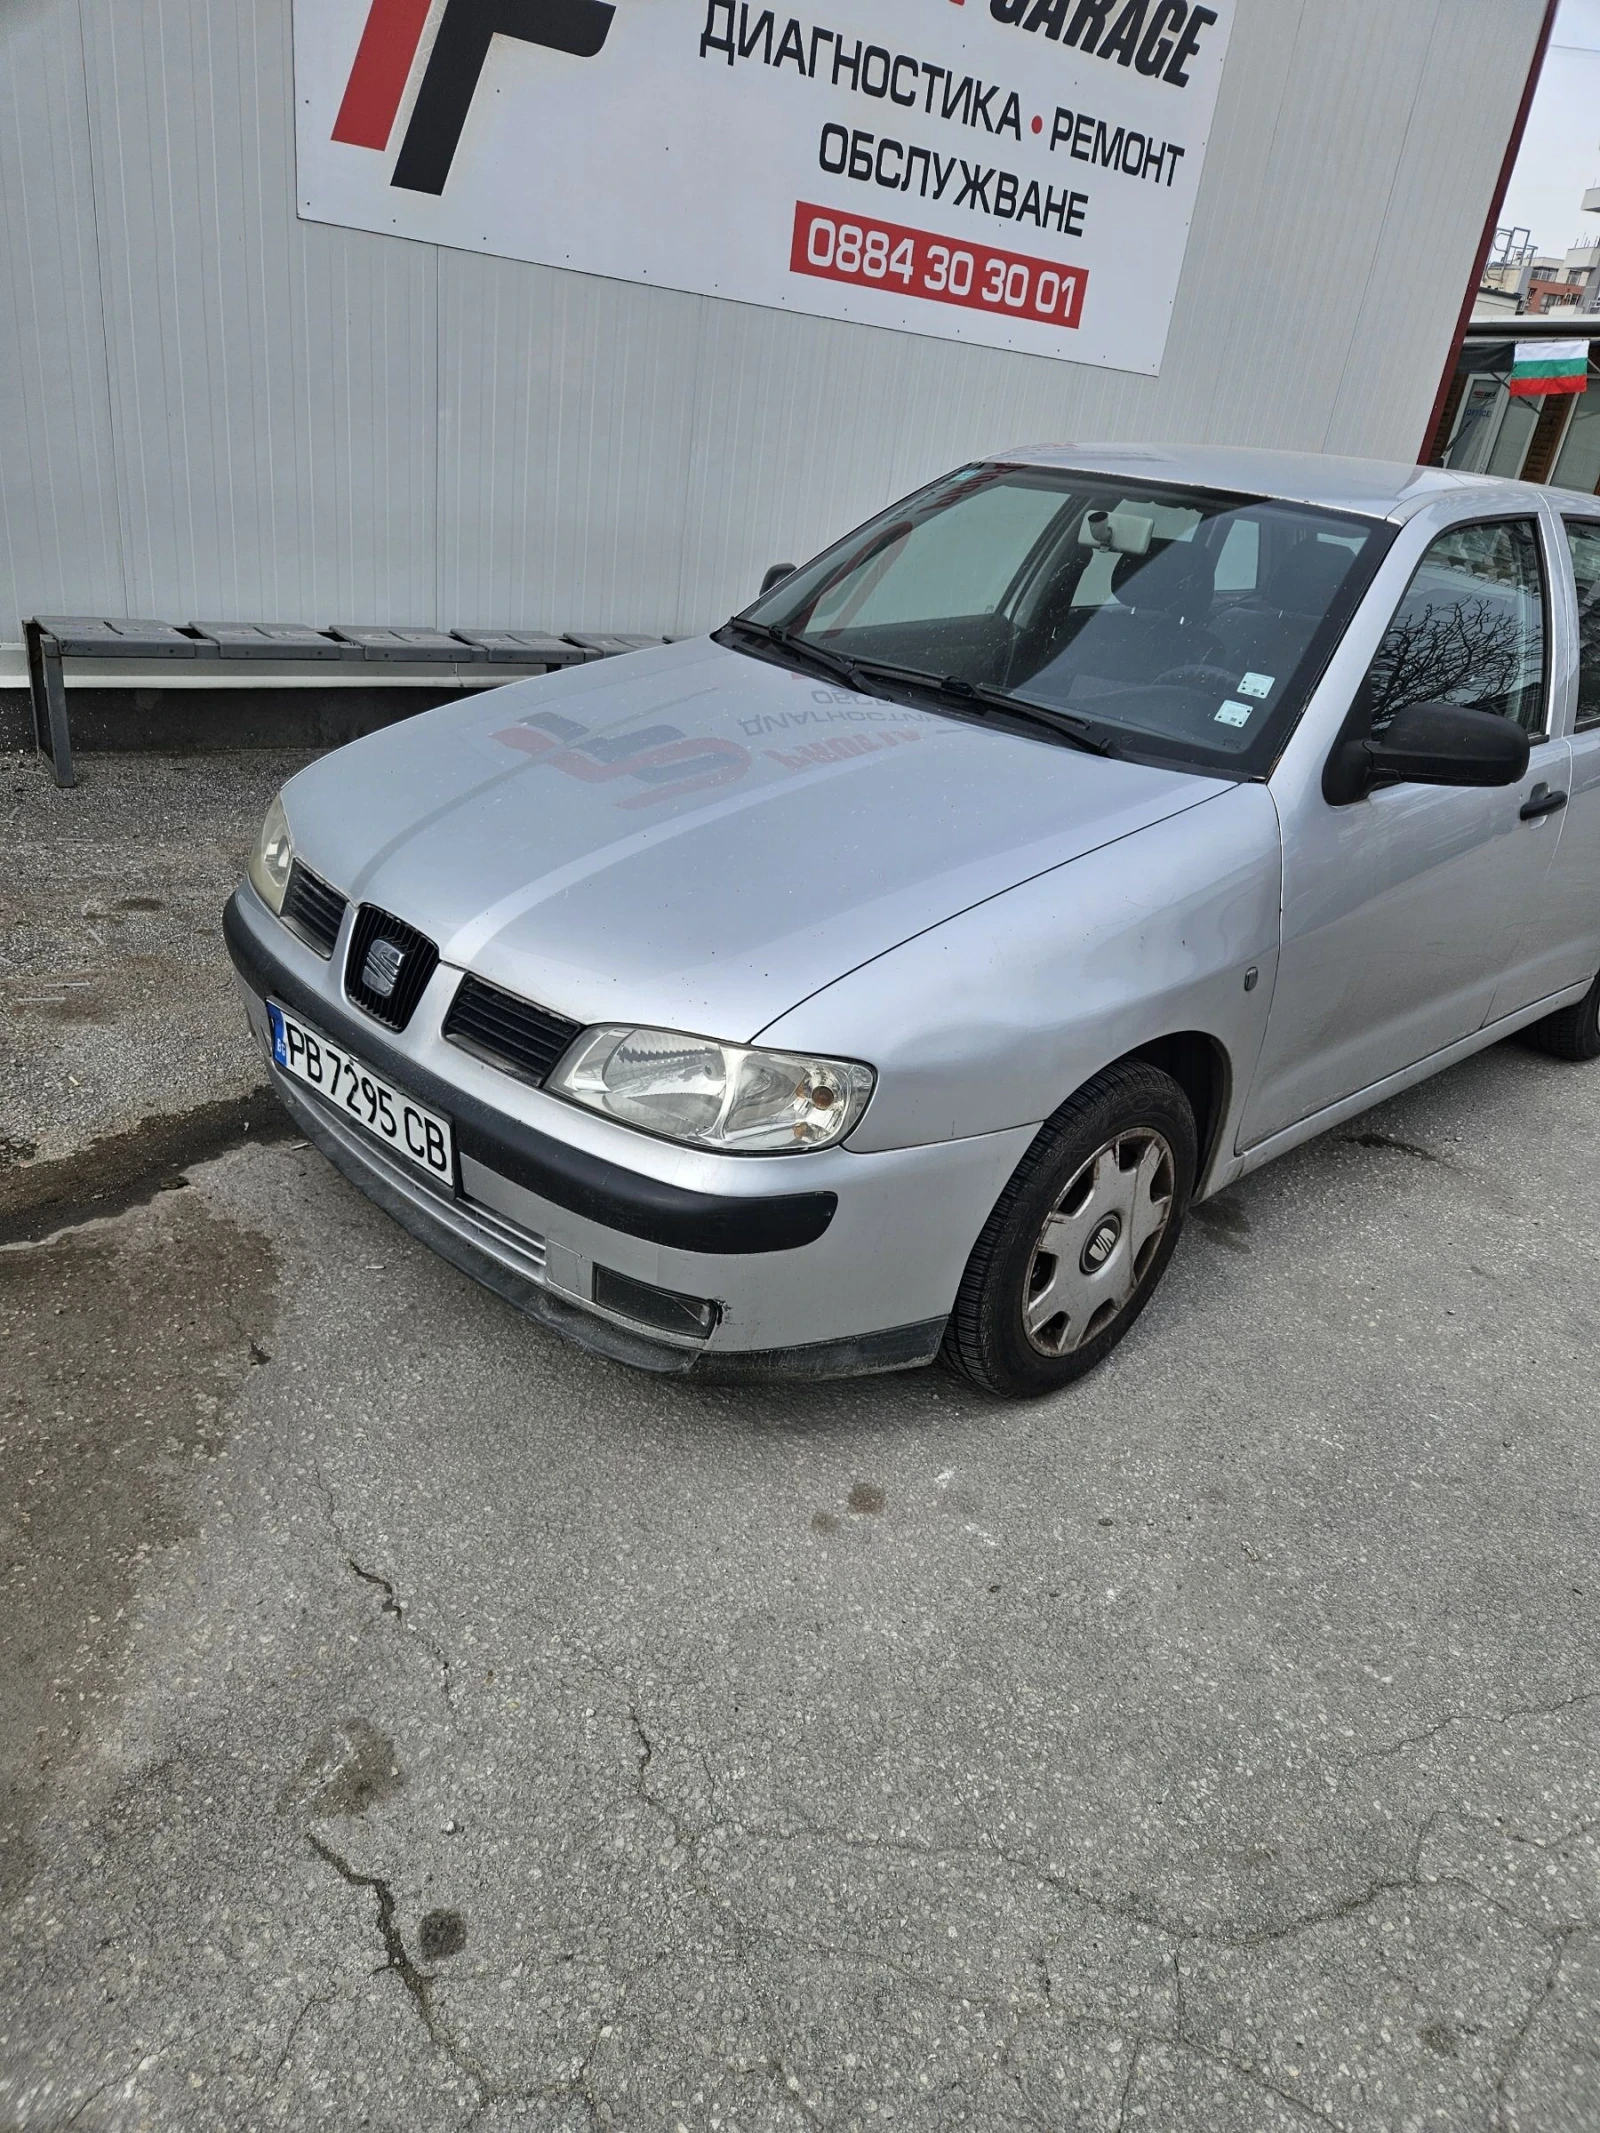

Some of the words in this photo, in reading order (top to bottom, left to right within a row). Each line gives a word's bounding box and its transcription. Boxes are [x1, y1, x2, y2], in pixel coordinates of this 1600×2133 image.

[700, 0, 1021, 141] ДИАГНОСТИКА
[1050, 106, 1186, 187] РЕМОНТ
[819, 122, 1089, 238] ОБСЛУЖВАНЕ
[807, 217, 915, 285] 0884
[924, 245, 974, 296] 30
[981, 258, 1030, 308] 30
[1036, 270, 1076, 318] 01
